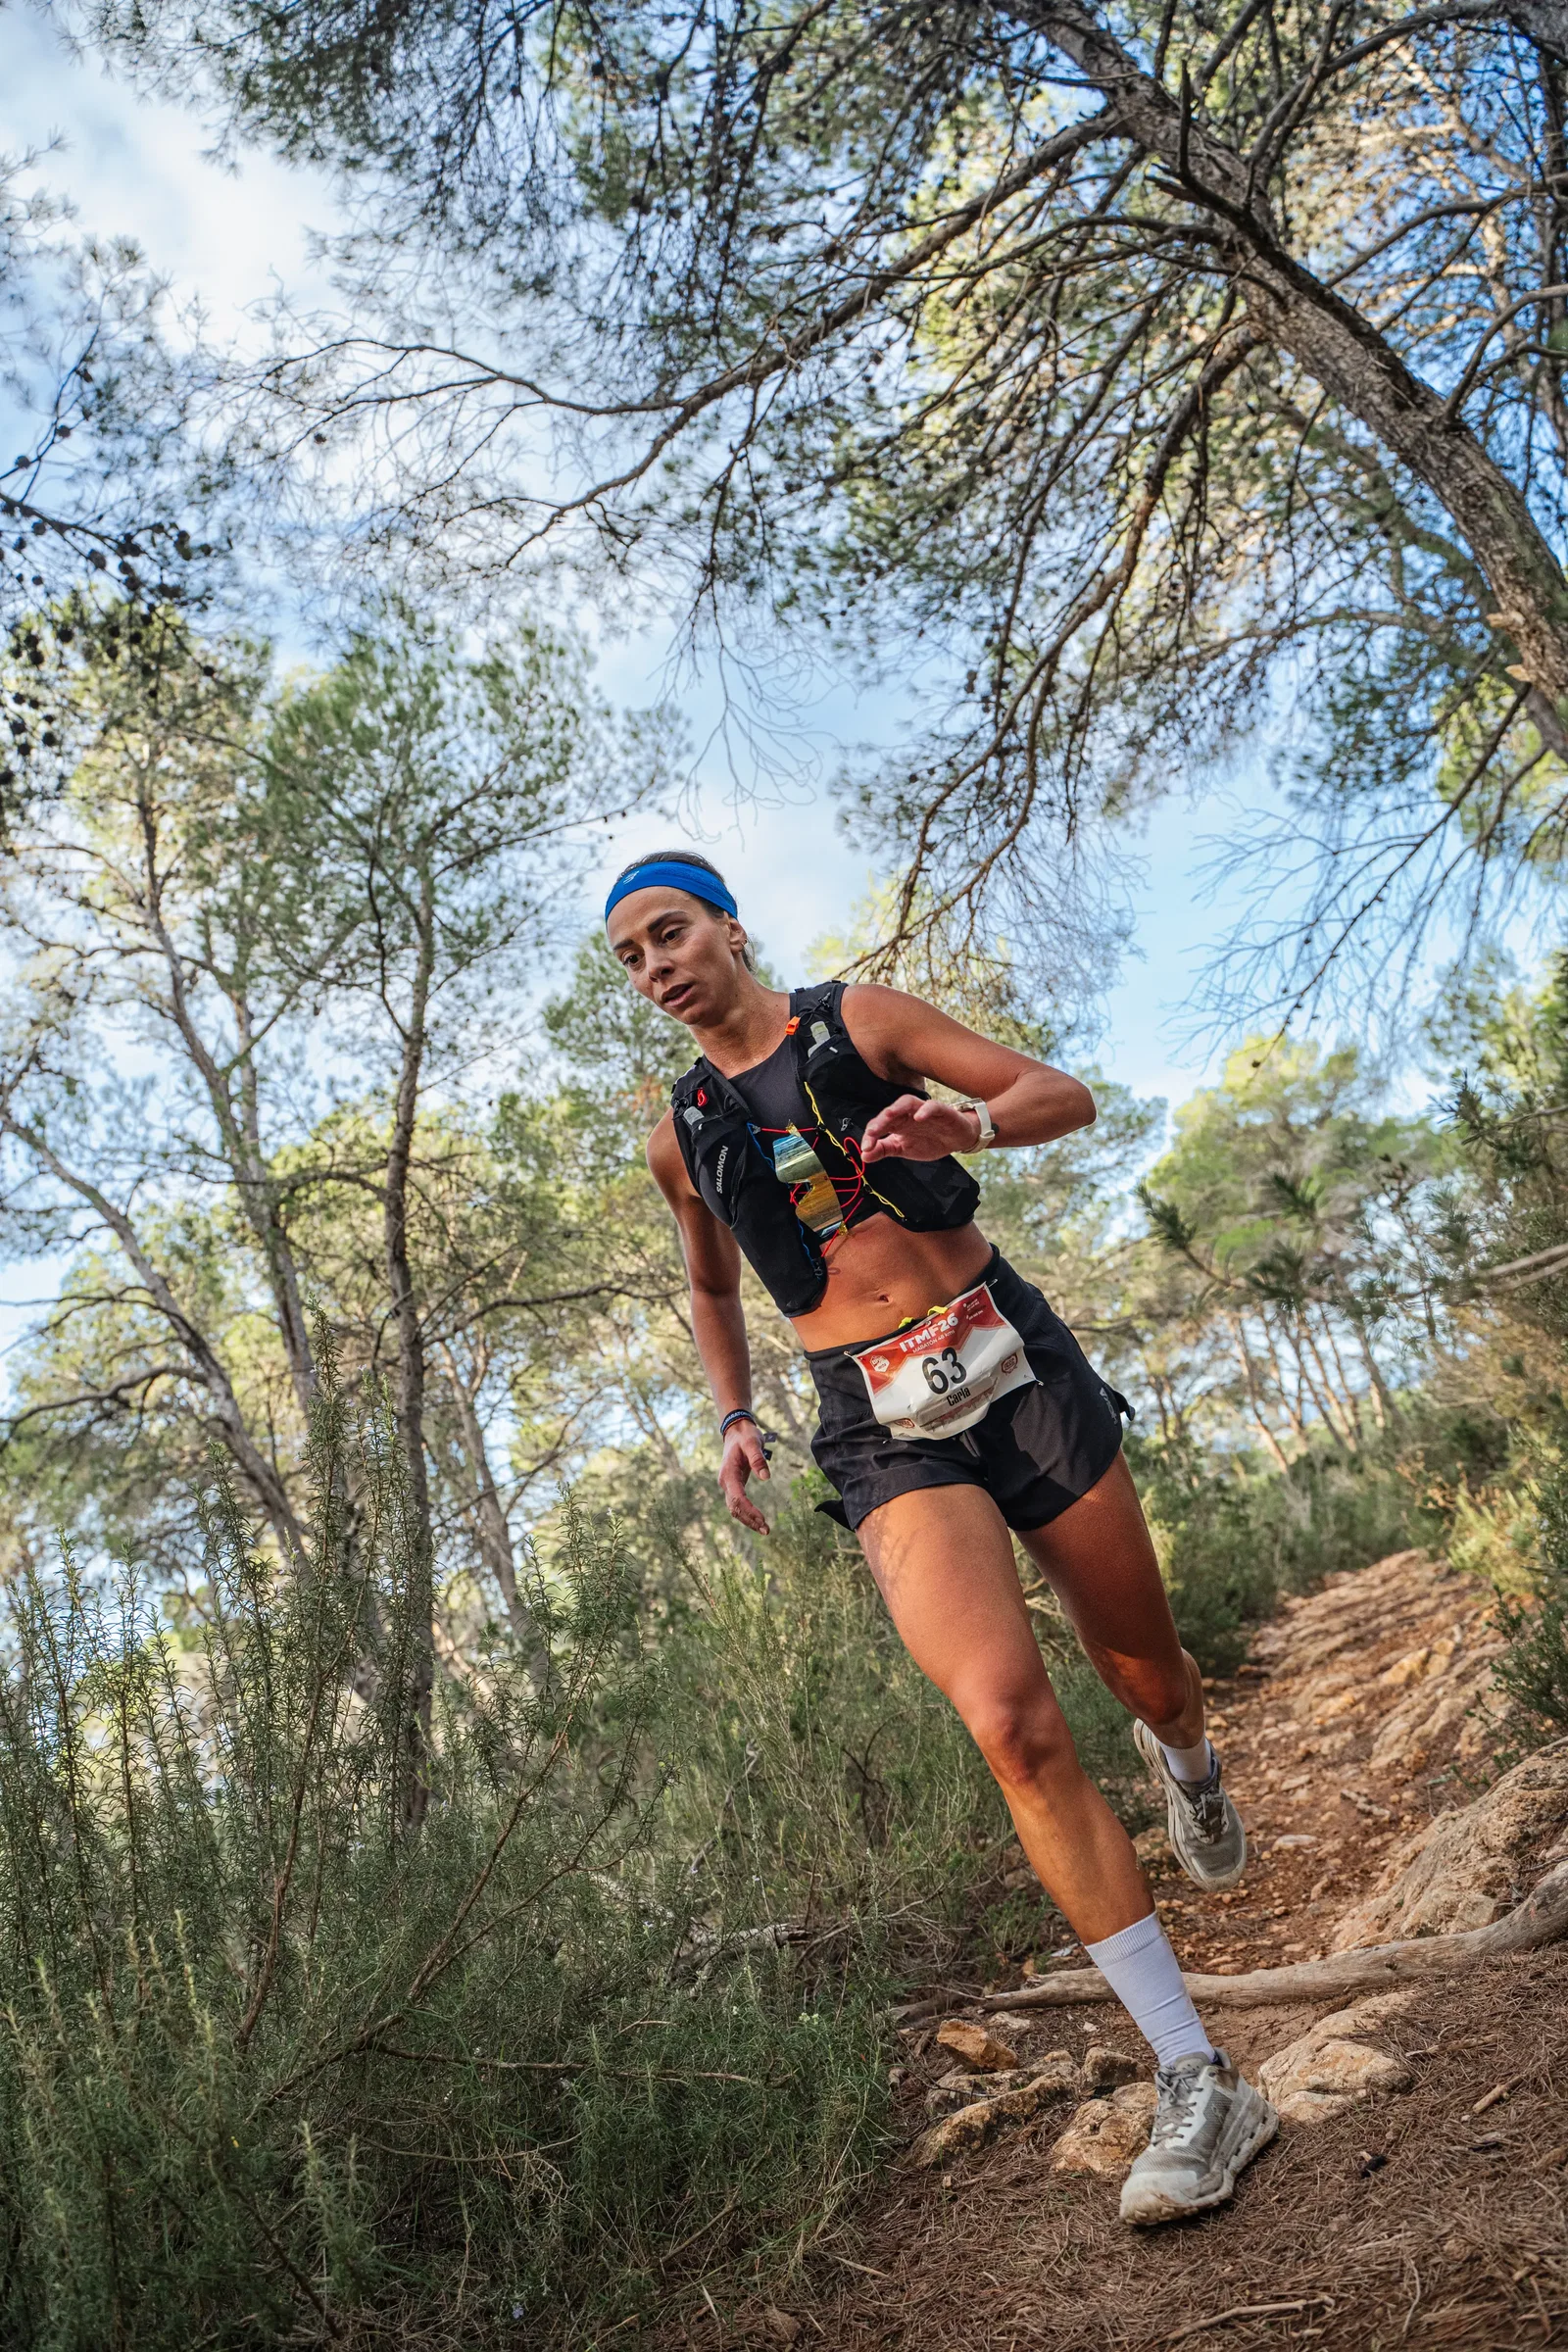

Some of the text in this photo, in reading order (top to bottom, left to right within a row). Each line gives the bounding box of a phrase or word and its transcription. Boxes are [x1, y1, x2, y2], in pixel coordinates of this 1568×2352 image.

[715, 1145, 729, 1195] SALOMON
[899, 1312, 958, 1352] ITMF26
[922, 1348, 967, 1395] 63
[947, 1387, 971, 1406] Carla
